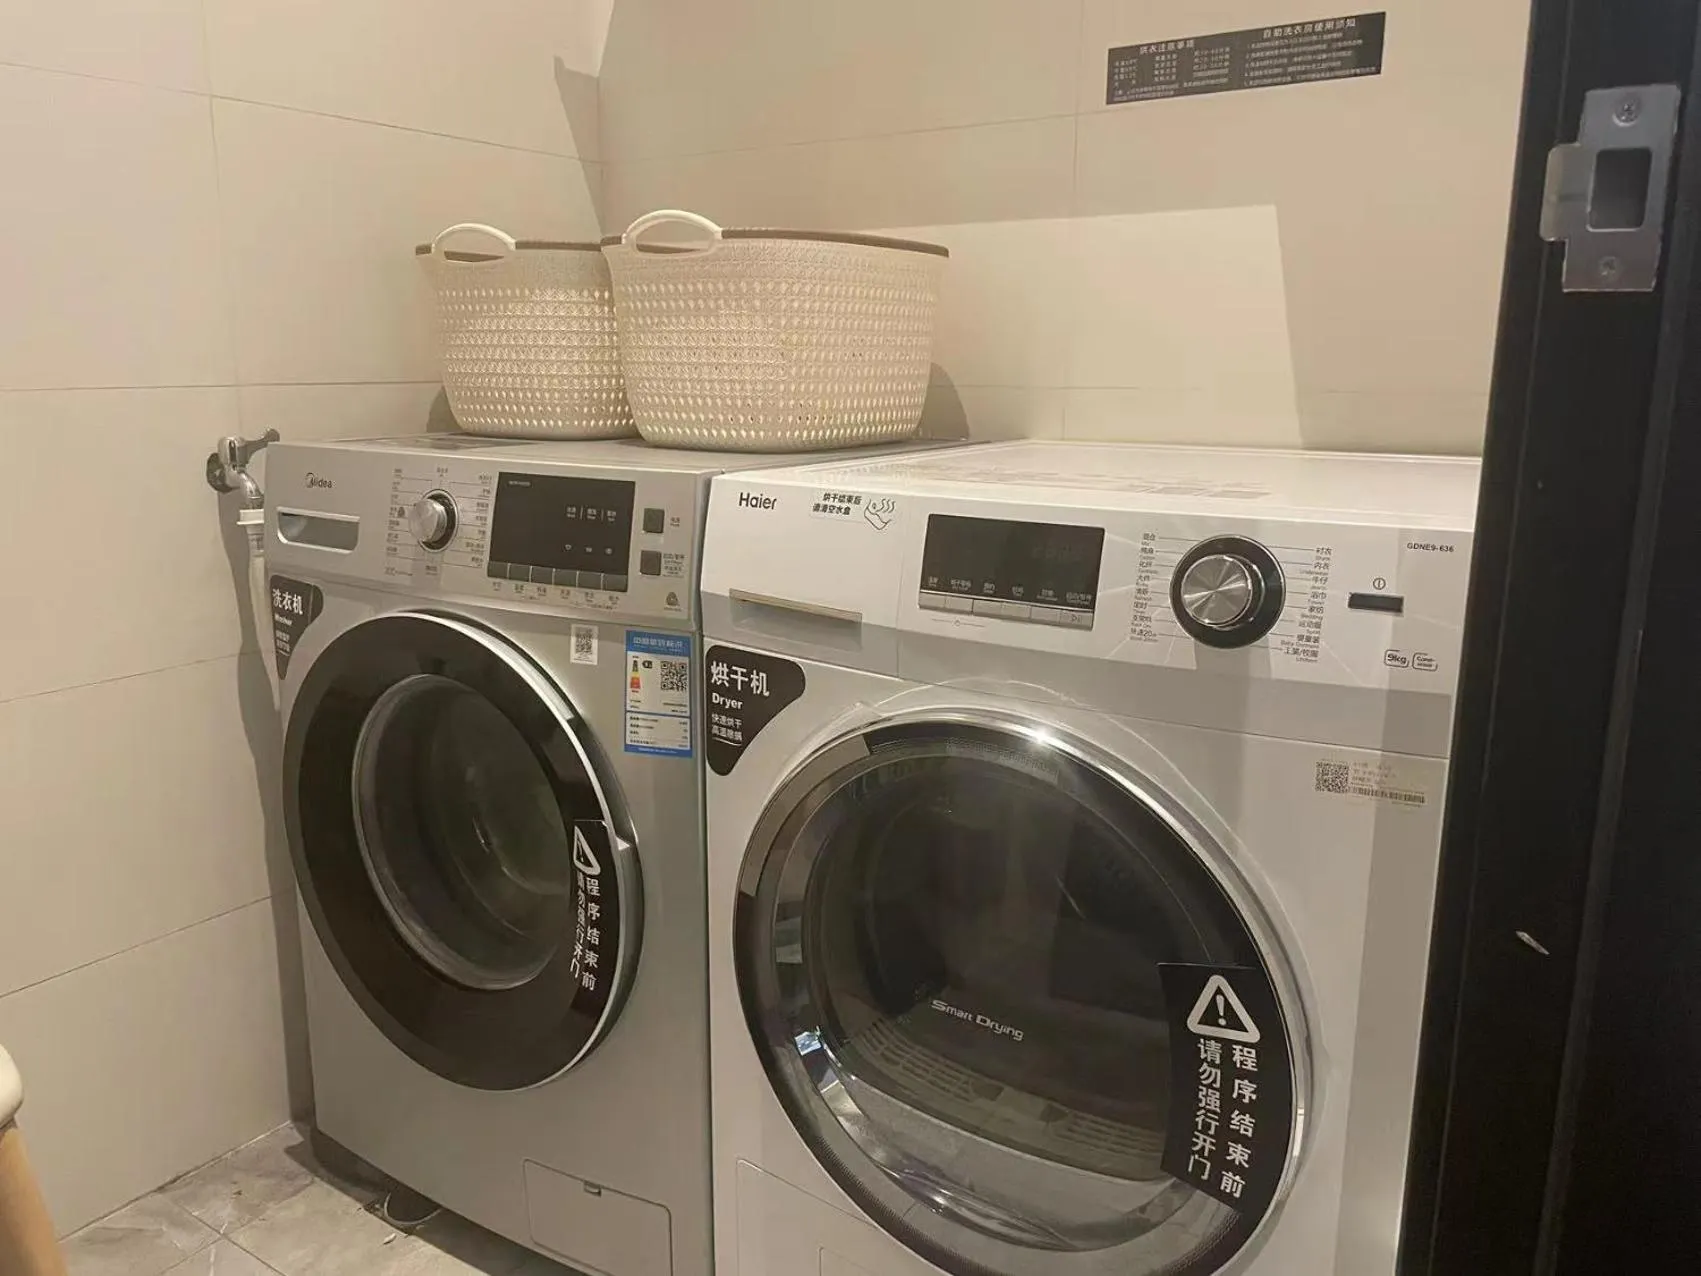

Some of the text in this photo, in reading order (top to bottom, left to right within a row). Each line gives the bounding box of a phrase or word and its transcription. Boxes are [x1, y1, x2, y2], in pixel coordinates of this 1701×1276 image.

[738, 491, 778, 511] Haier
[823, 492, 862, 505] 烘干结束后
[1406, 542, 1455, 553] GDNE9-636
[272, 587, 303, 616] 洗衣机
[1387, 653, 1407, 665] 9kg
[710, 660, 770, 697] 烘干机
[711, 692, 744, 710] Dryer
[581, 877, 601, 992] 程序结束前
[931, 999, 1025, 1042] Smart Drying
[1187, 1038, 1222, 1181] 请勿强行开门
[1218, 1043, 1259, 1199] 程序结束前
